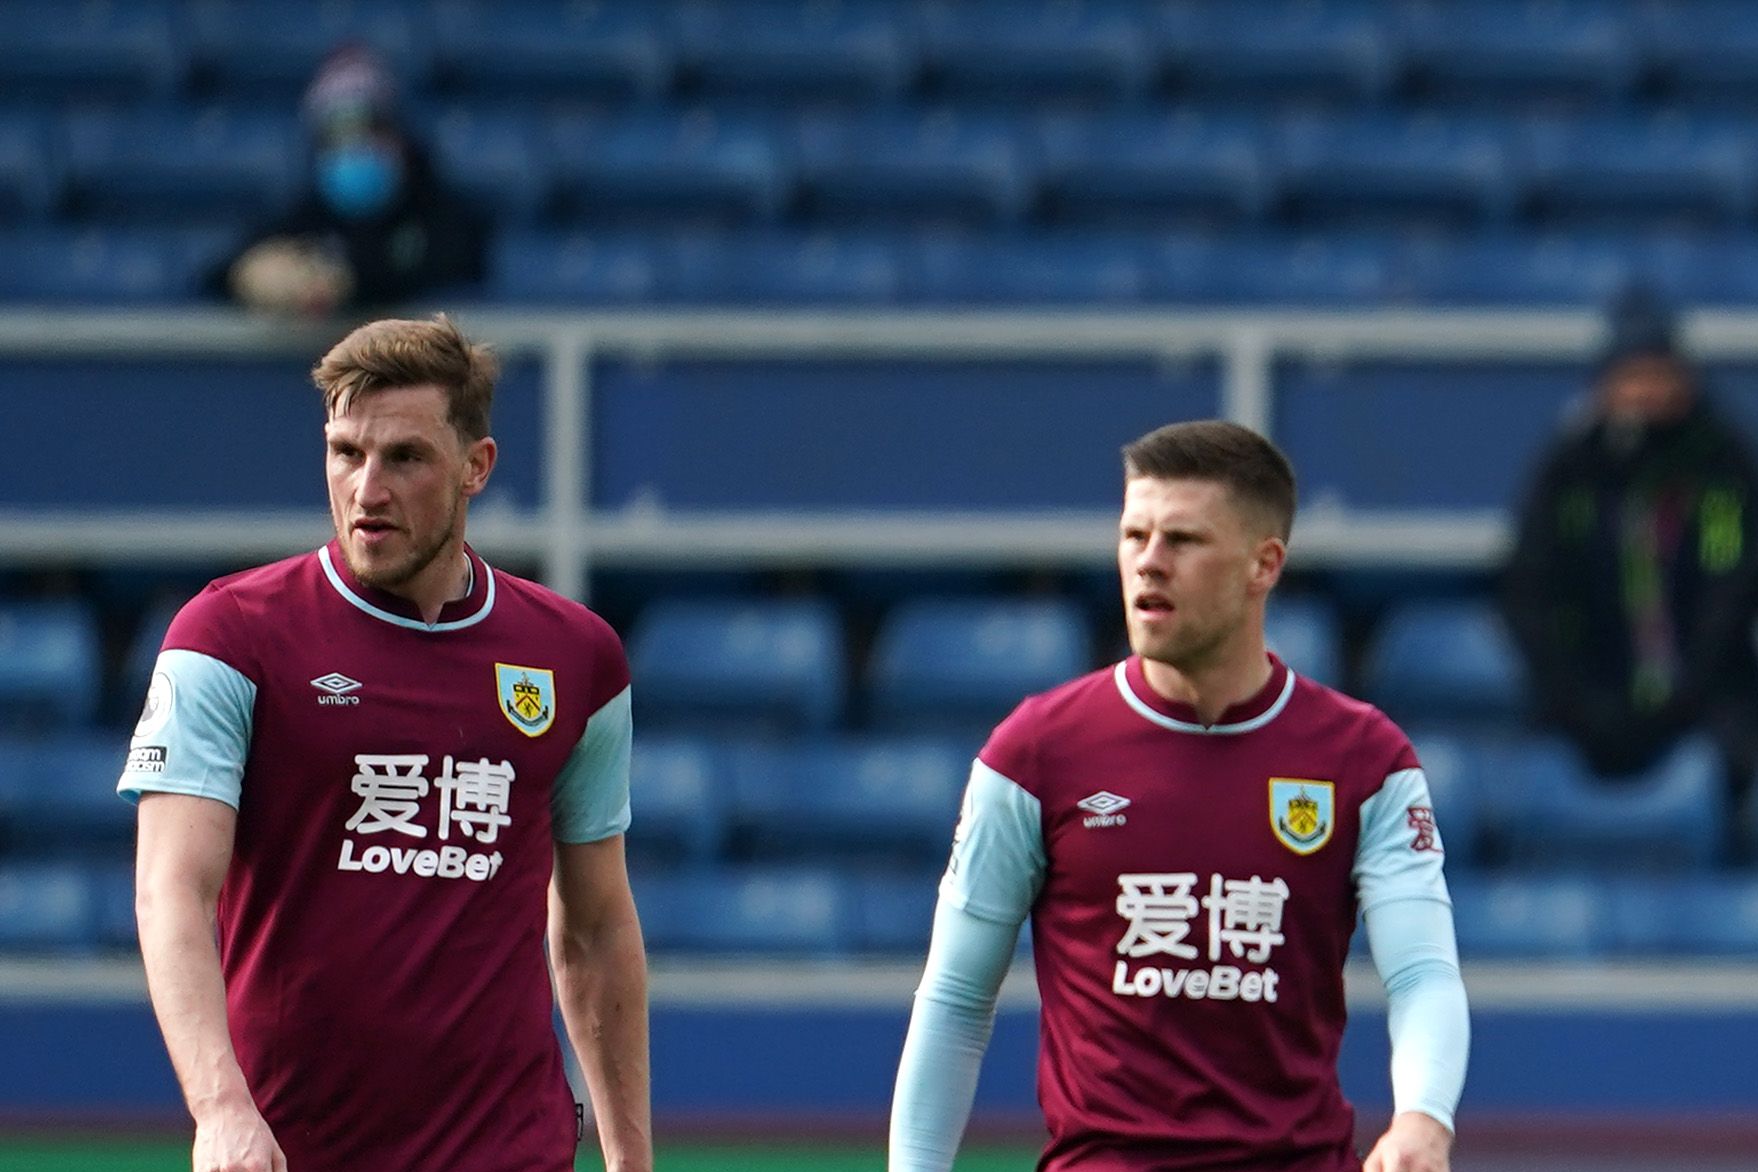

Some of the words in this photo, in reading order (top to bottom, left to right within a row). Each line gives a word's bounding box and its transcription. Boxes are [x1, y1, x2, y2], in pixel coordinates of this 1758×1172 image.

[317, 693, 360, 706] umbro
[337, 839, 503, 881] LoveBet
[1112, 960, 1279, 1004] LoveBet
